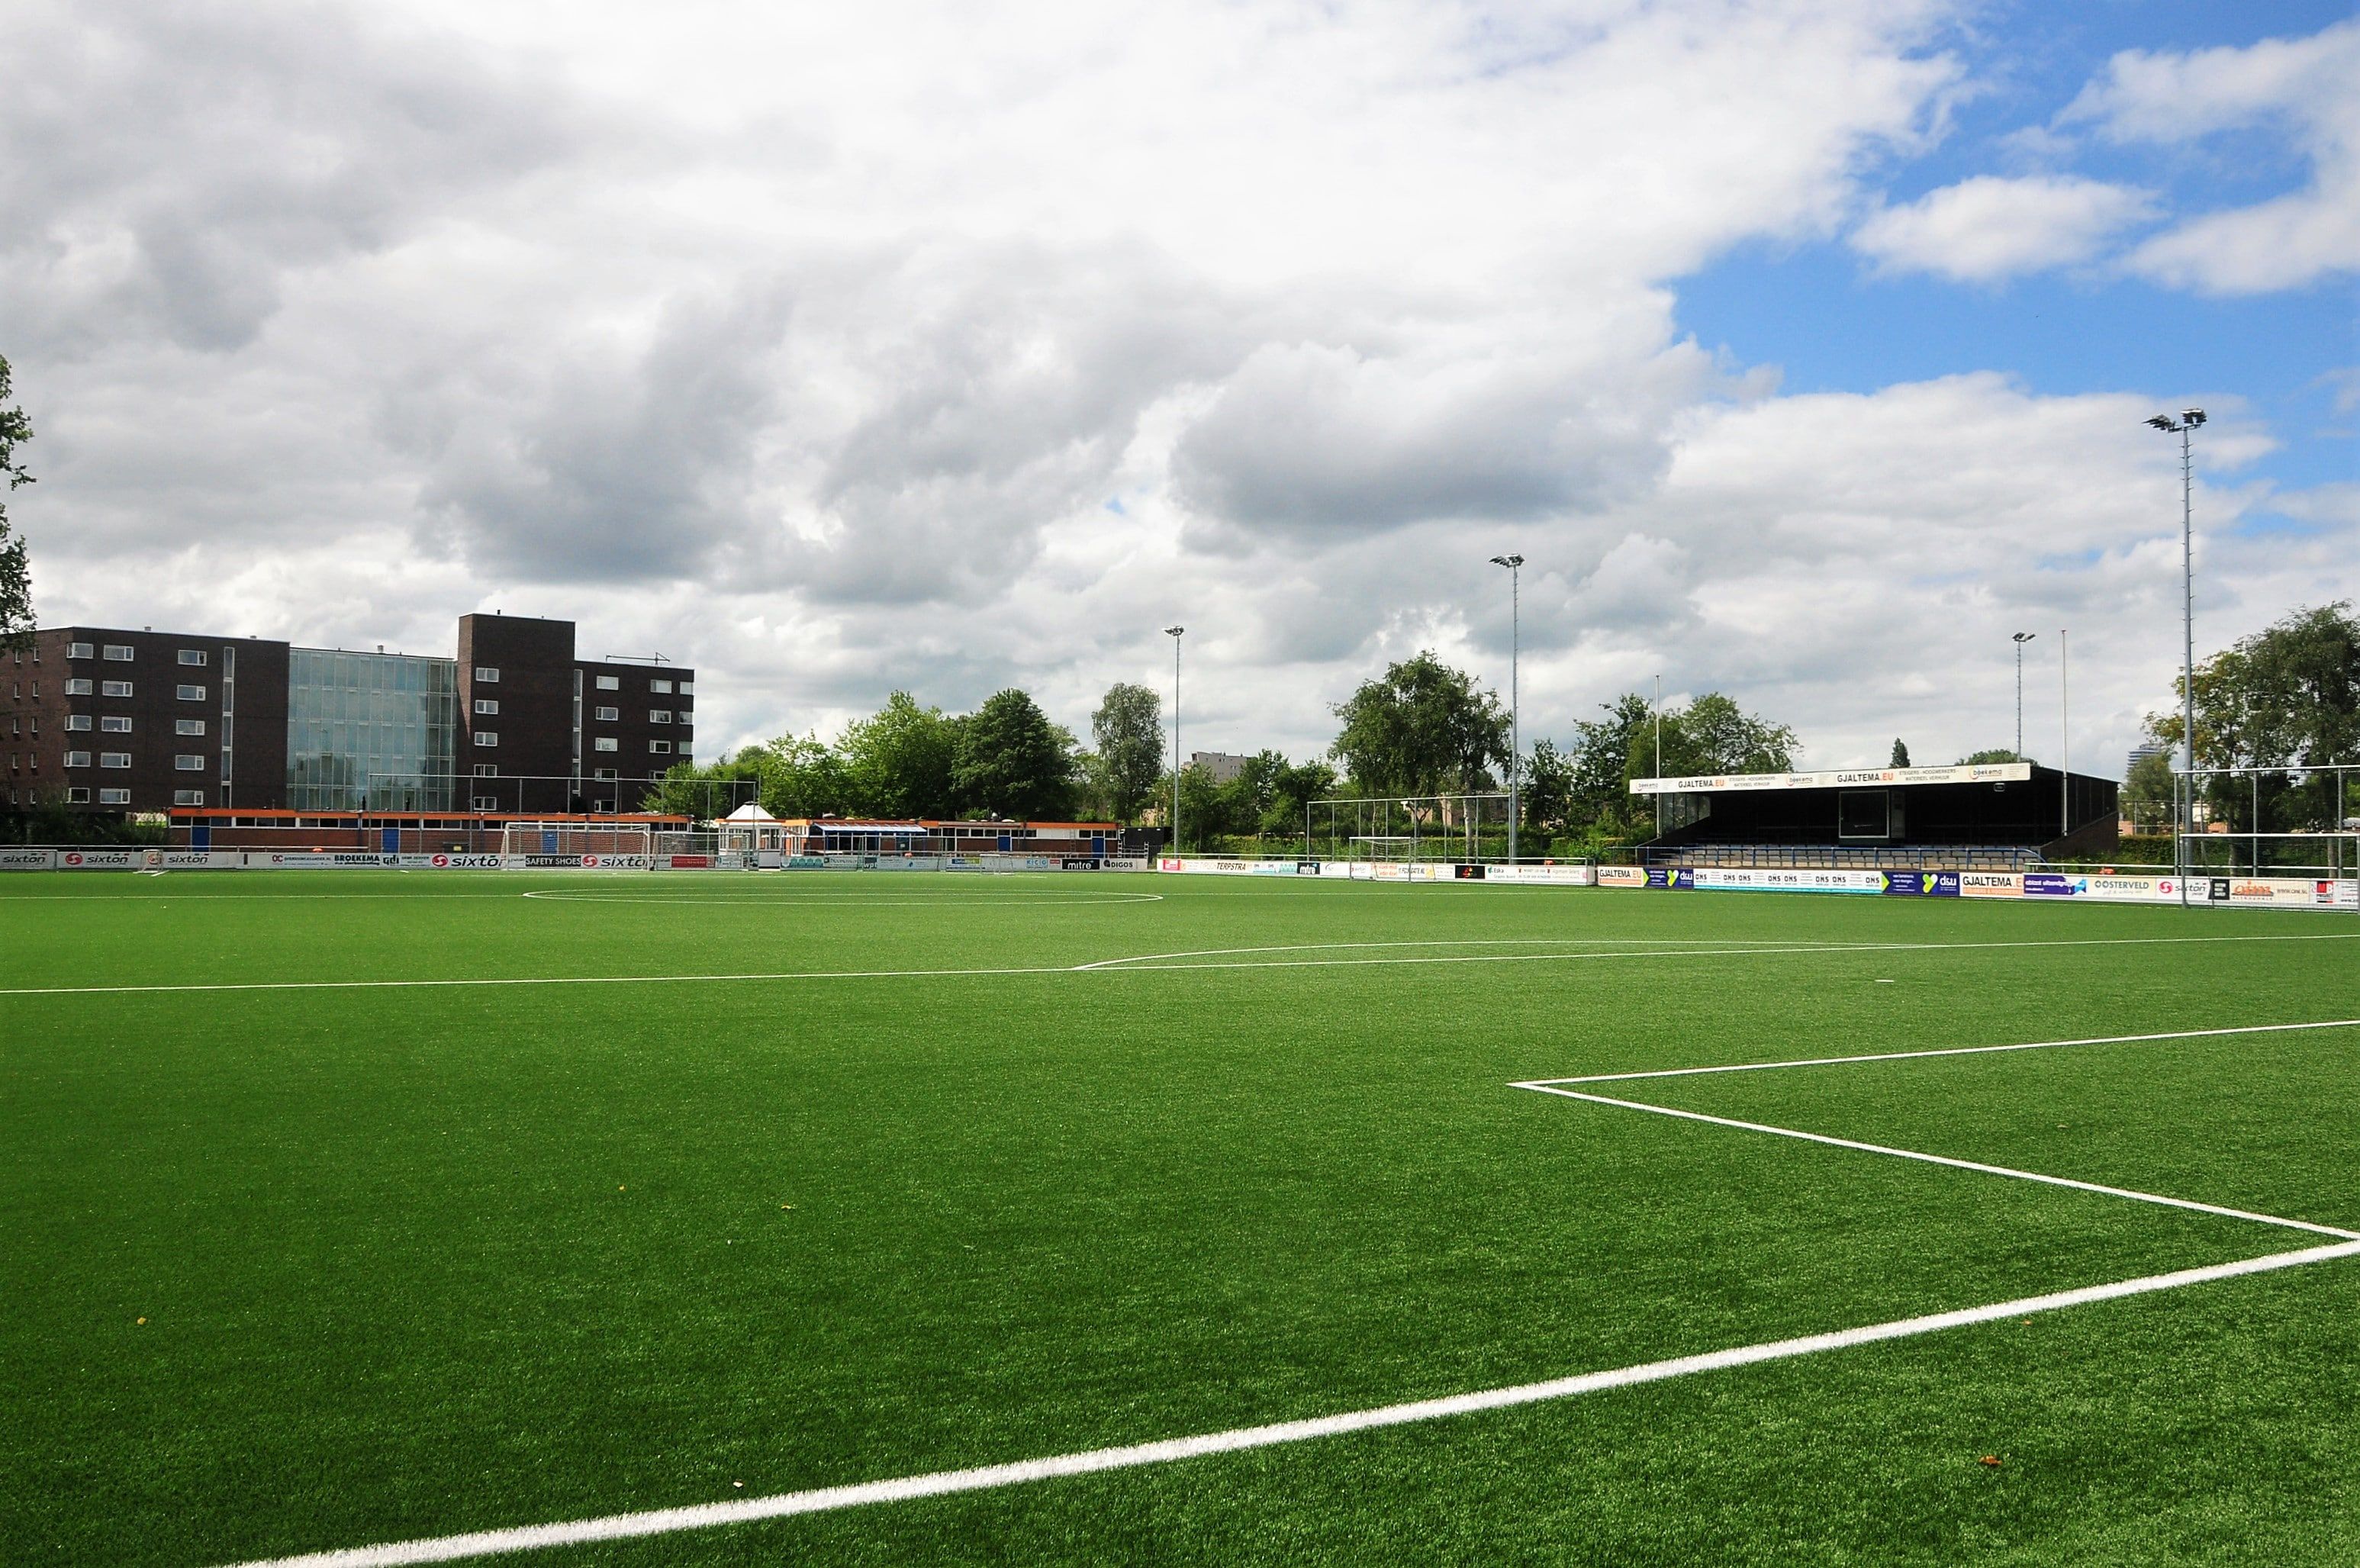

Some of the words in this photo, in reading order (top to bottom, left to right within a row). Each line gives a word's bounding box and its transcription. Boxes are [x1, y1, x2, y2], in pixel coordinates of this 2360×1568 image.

[526, 857, 553, 865] SAFETY
[555, 857, 581, 865] SHOES
[1067, 861, 1092, 869] mitre
[1217, 862, 1246, 871] TERPSTRA
[1299, 864, 1315, 874] mitre
[1962, 876, 2022, 887] GJALTEMA.E
[2094, 881, 2149, 889] OOSTERVELD
